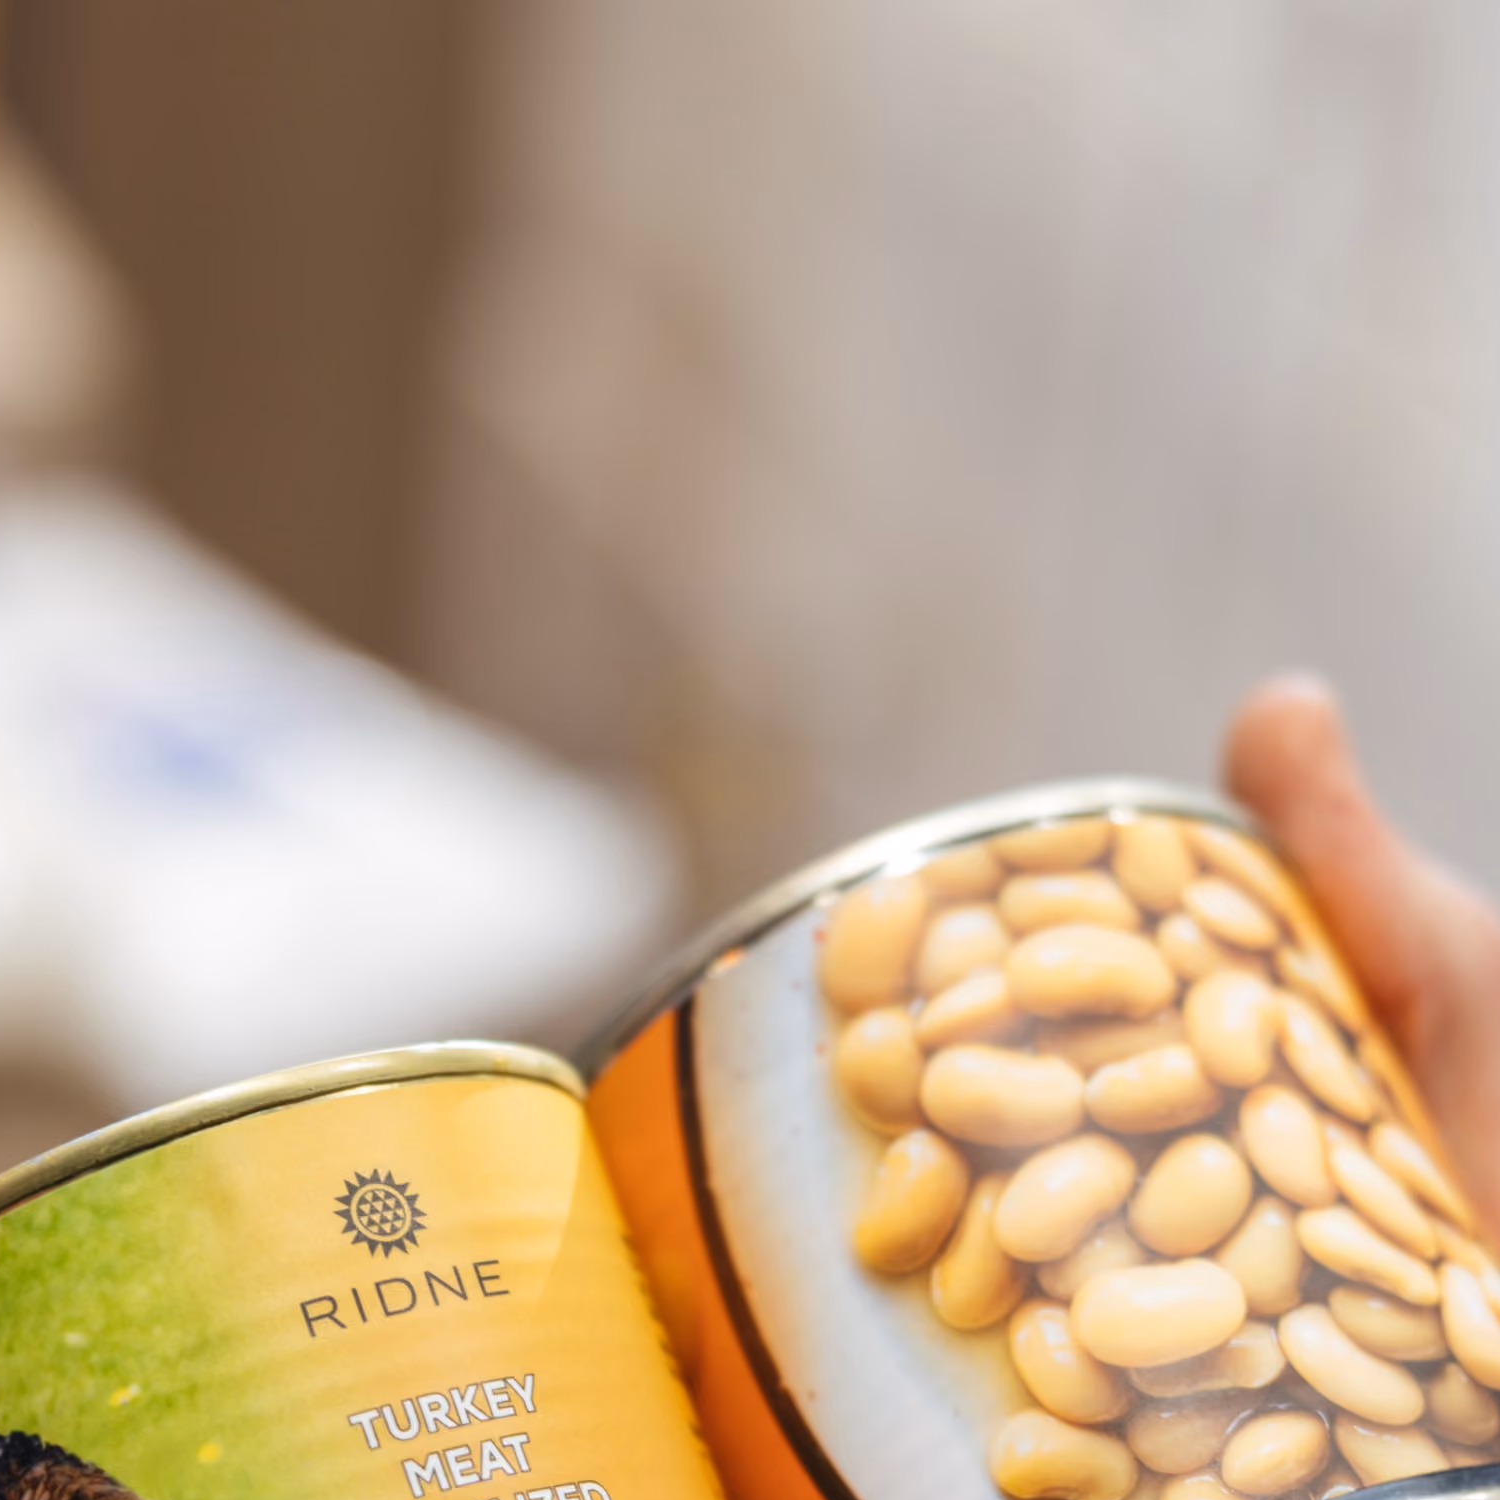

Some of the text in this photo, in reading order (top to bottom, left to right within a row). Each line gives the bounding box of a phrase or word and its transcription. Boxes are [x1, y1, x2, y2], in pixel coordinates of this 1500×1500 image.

[299, 1259, 510, 1337] RIDNE
[349, 1373, 537, 1449] TURKEY
[401, 1432, 532, 1498] MEAT
